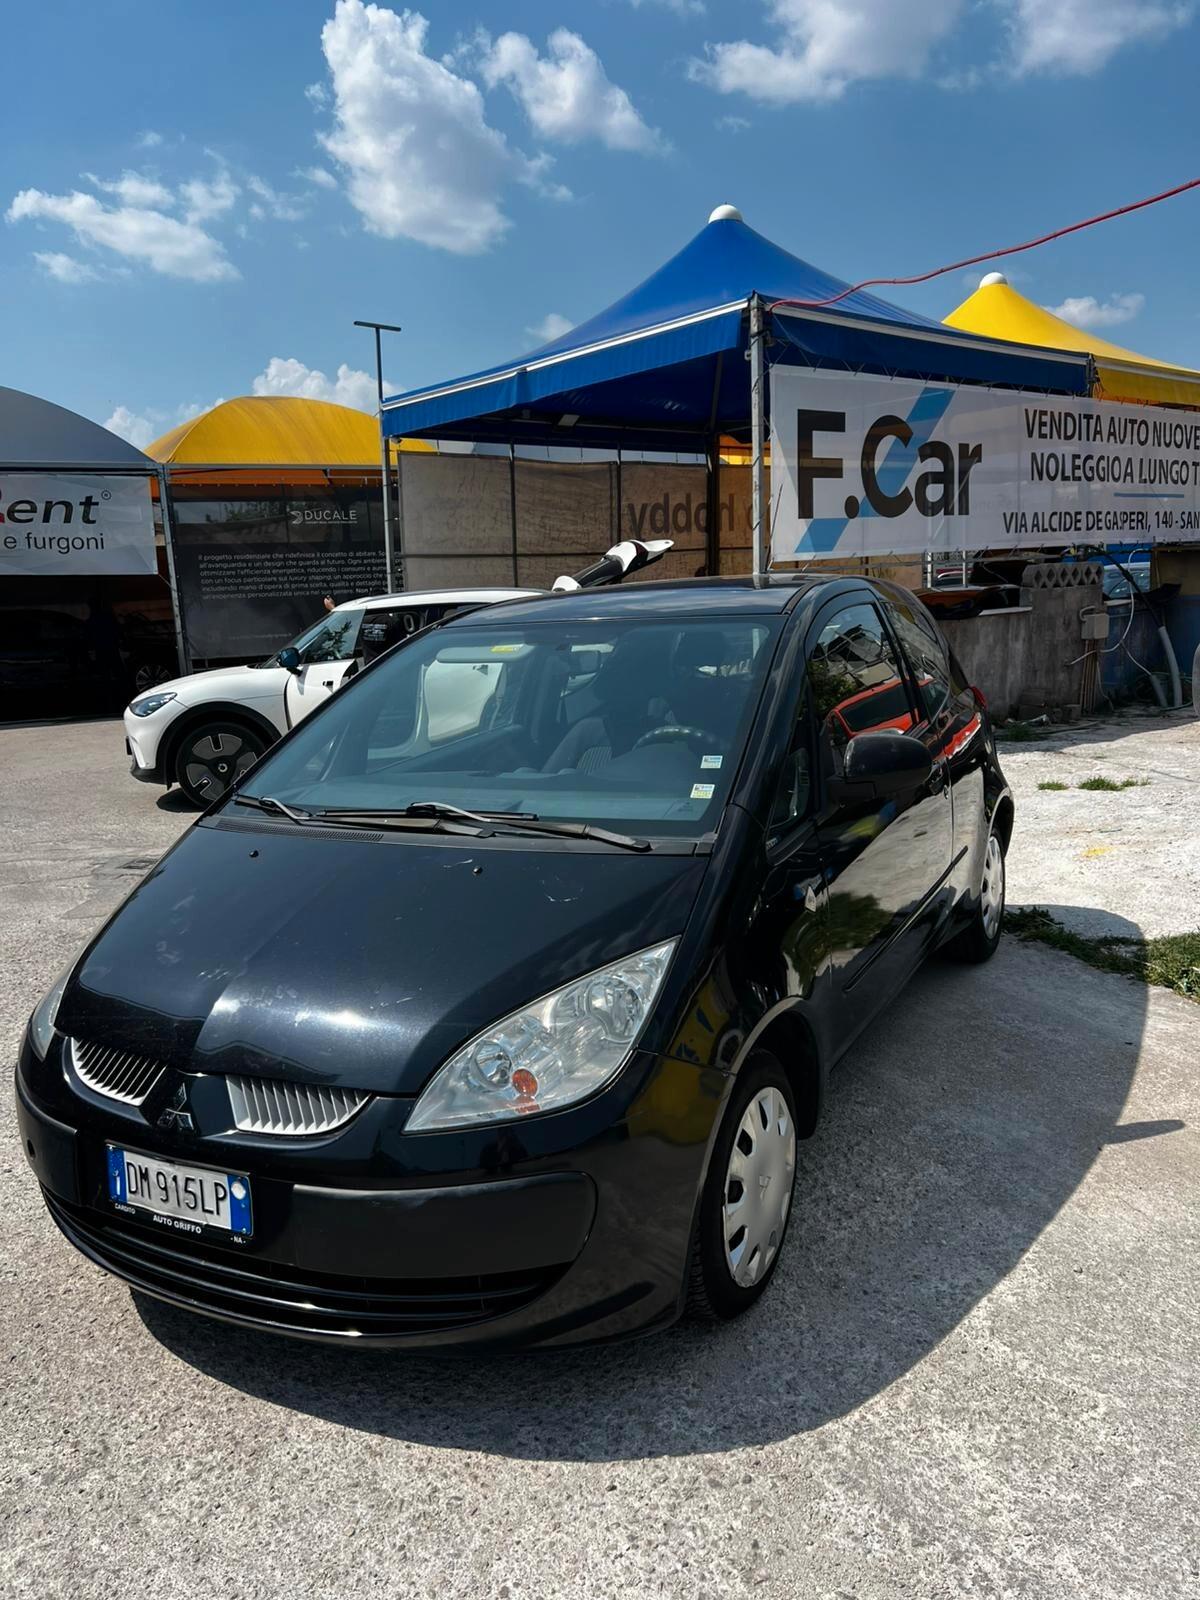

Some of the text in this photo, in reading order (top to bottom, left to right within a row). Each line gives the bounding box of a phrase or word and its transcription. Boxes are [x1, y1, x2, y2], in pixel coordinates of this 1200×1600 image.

[1025, 408, 1200, 450] VENDITA AUTO NUOVE
[797, 408, 983, 519] F.Car
[1030, 452, 1122, 482] NOLEGGIO
[1123, 457, 1134, 483] A
[1138, 457, 1190, 486] LUNGO
[0, 489, 99, 525] ent
[304, 510, 358, 520] DUCALE
[1003, 512, 1028, 534] VIA
[1031, 511, 1083, 533] ALCIDE
[1086, 511, 1103, 531] DE
[1154, 511, 1174, 529] 140
[4, 532, 105, 555] e furgoni
[204, 554, 232, 562] progetto
[126, 1161, 228, 1216] DM 915LP
[114, 1202, 136, 1215] CARDITO
[153, 1214, 203, 1235] AUTO GRIFFO
